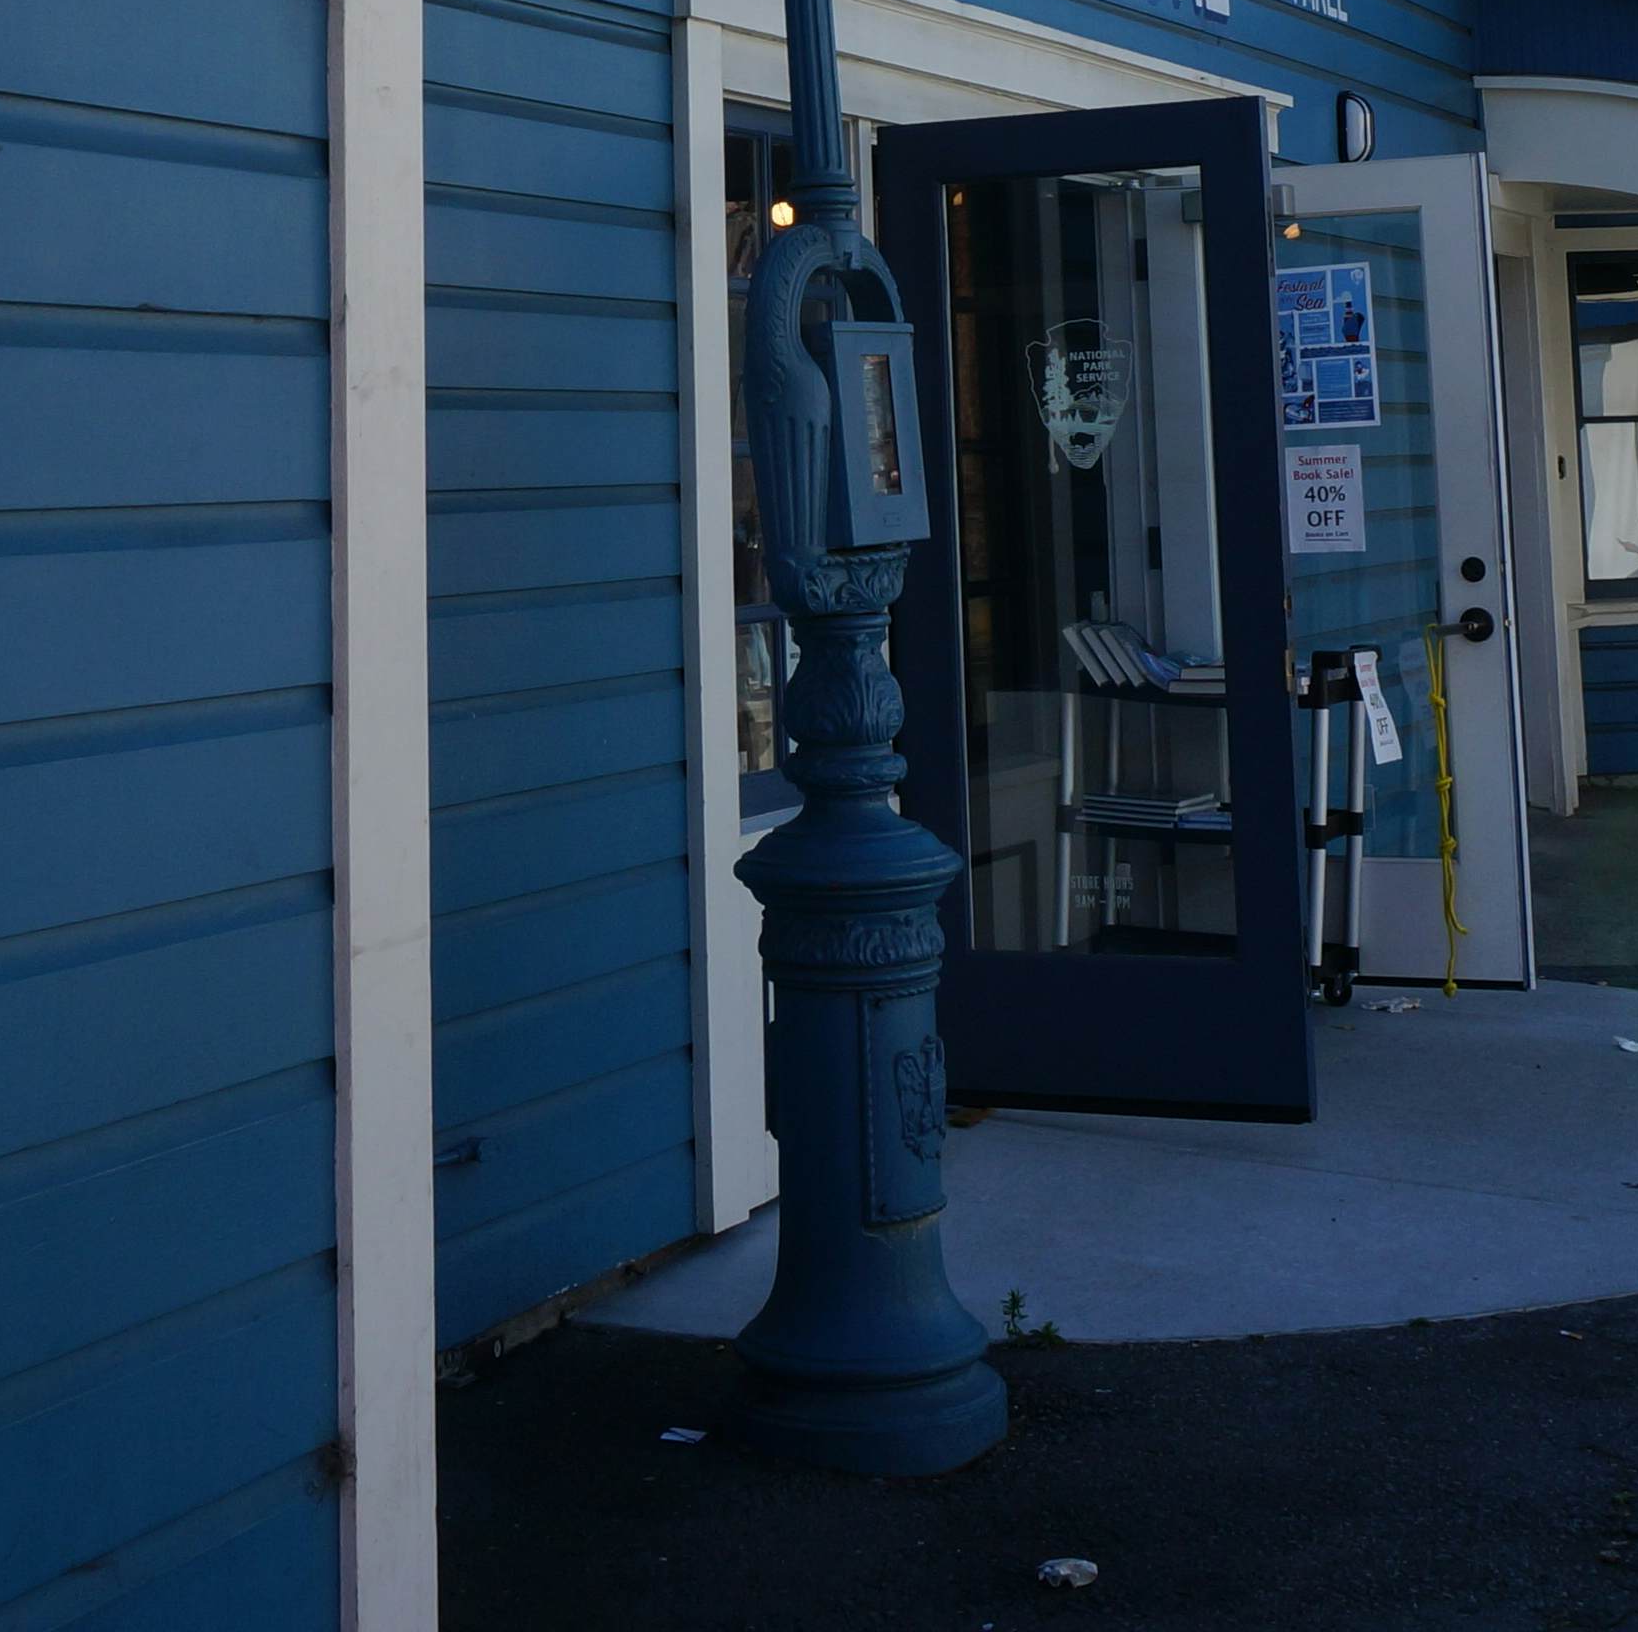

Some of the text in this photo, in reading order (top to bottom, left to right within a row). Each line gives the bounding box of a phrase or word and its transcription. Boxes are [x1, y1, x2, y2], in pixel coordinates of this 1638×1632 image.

[1069, 349, 1126, 361] NATIONAL
[1083, 362, 1111, 371] PARK
[1076, 371, 1121, 383] SERVICE
[1298, 455, 1347, 466] Summer
[1293, 468, 1354, 480] Book Sale!
[1304, 484, 1346, 503] 40%
[1307, 510, 1345, 527] OFF
[1070, 875, 1135, 891] STORE HOURS
